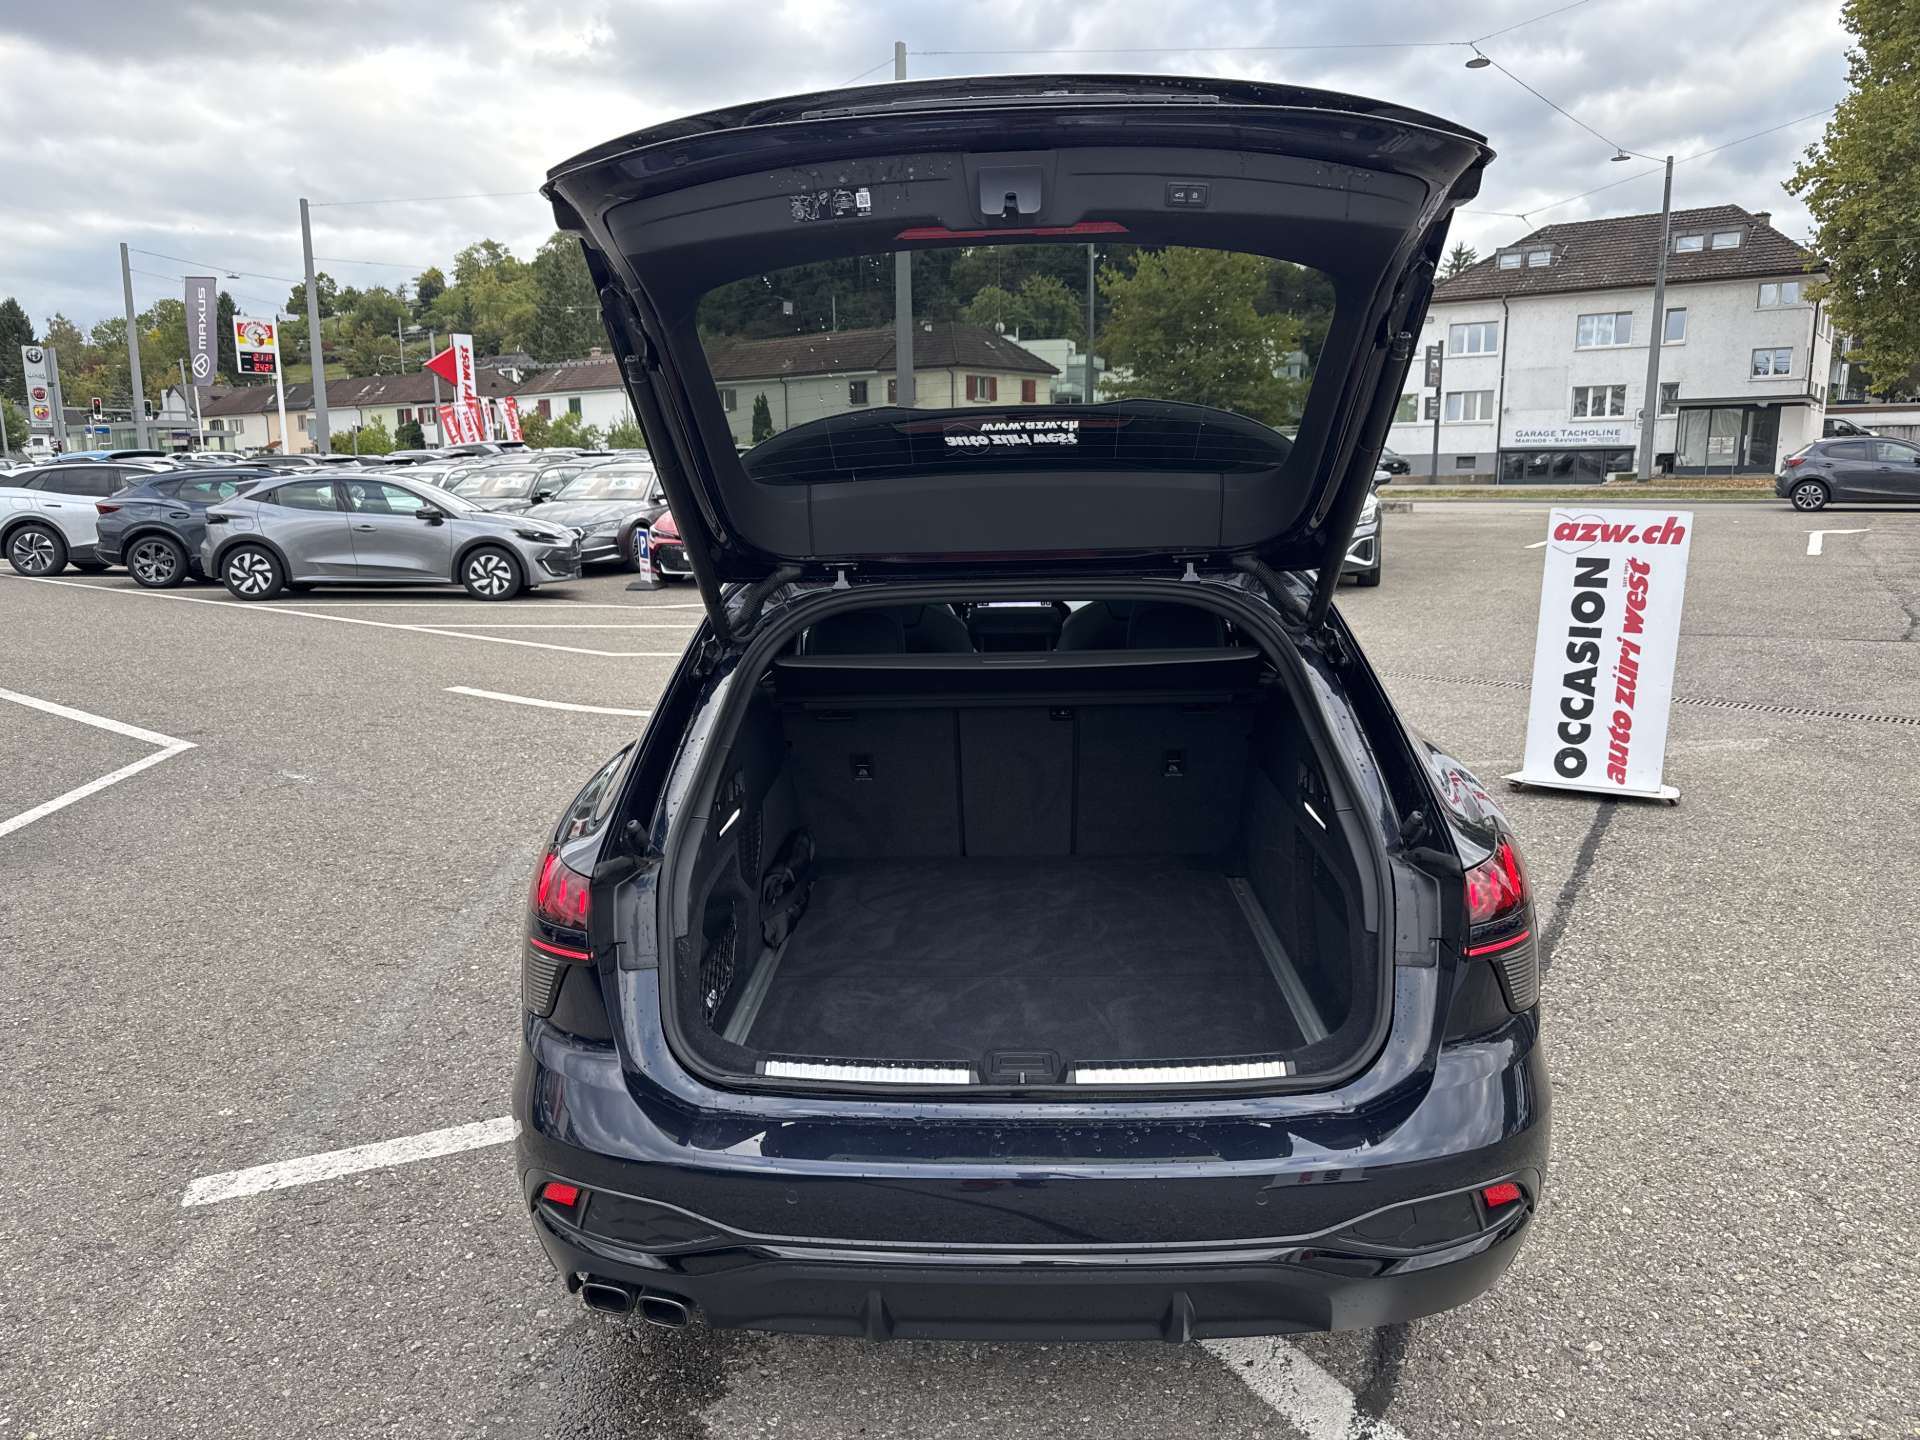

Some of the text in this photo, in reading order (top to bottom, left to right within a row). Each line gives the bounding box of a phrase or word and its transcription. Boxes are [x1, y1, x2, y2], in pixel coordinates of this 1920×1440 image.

[197, 286, 207, 350] MAXUS
[1515, 428, 1622, 438] GARAGE TACHOLINE
[640, 535, 646, 555] P
[1553, 516, 1686, 545] azw.ch
[1553, 556, 1611, 779] OCCASION
[1606, 556, 1651, 785] auto züri west
